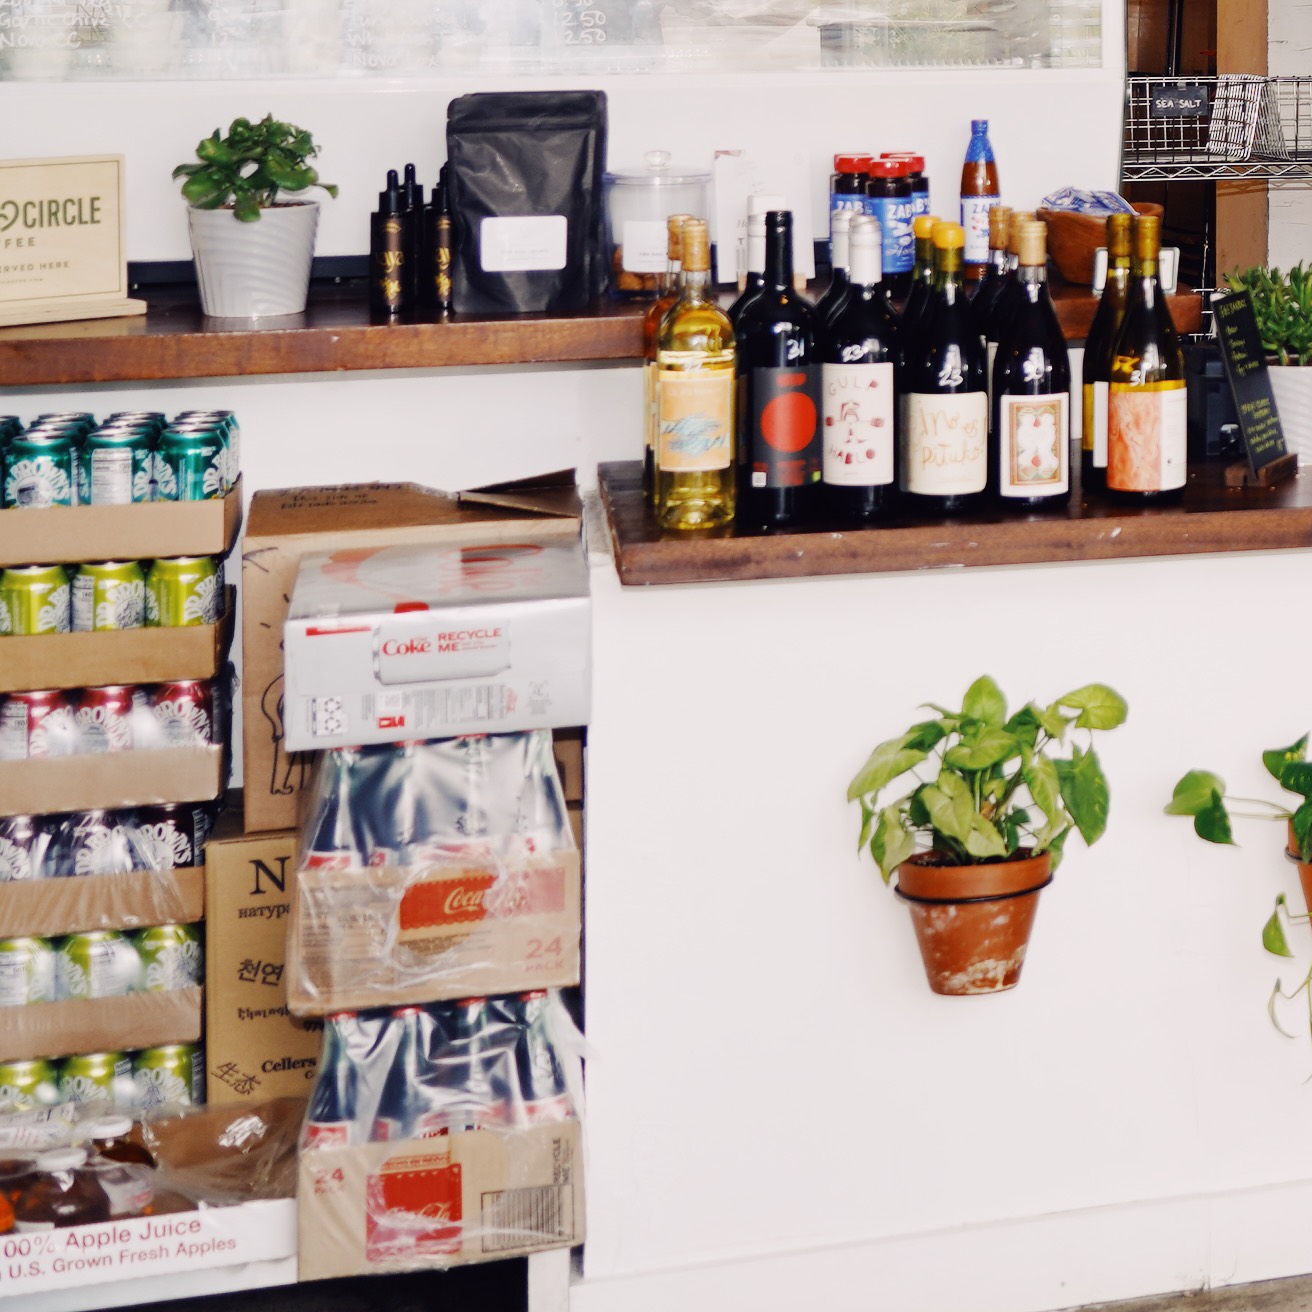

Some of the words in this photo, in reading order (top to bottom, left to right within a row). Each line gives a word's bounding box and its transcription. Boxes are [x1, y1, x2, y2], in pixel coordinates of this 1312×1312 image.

[1155, 98, 1174, 109] SEA
[1178, 99, 1202, 109] SALT
[23, 196, 102, 229] CIRCLE
[437, 627, 502, 642] RECYCLE
[382, 637, 432, 657] Coke
[438, 642, 461, 654] ME
[66, 1225, 131, 1252] Apple
[139, 1218, 202, 1240] Juice
[9, 1260, 46, 1280] U.S.
[53, 1254, 113, 1274] Grown
[119, 1245, 170, 1266] Fresh
[175, 1237, 238, 1259] Apples
